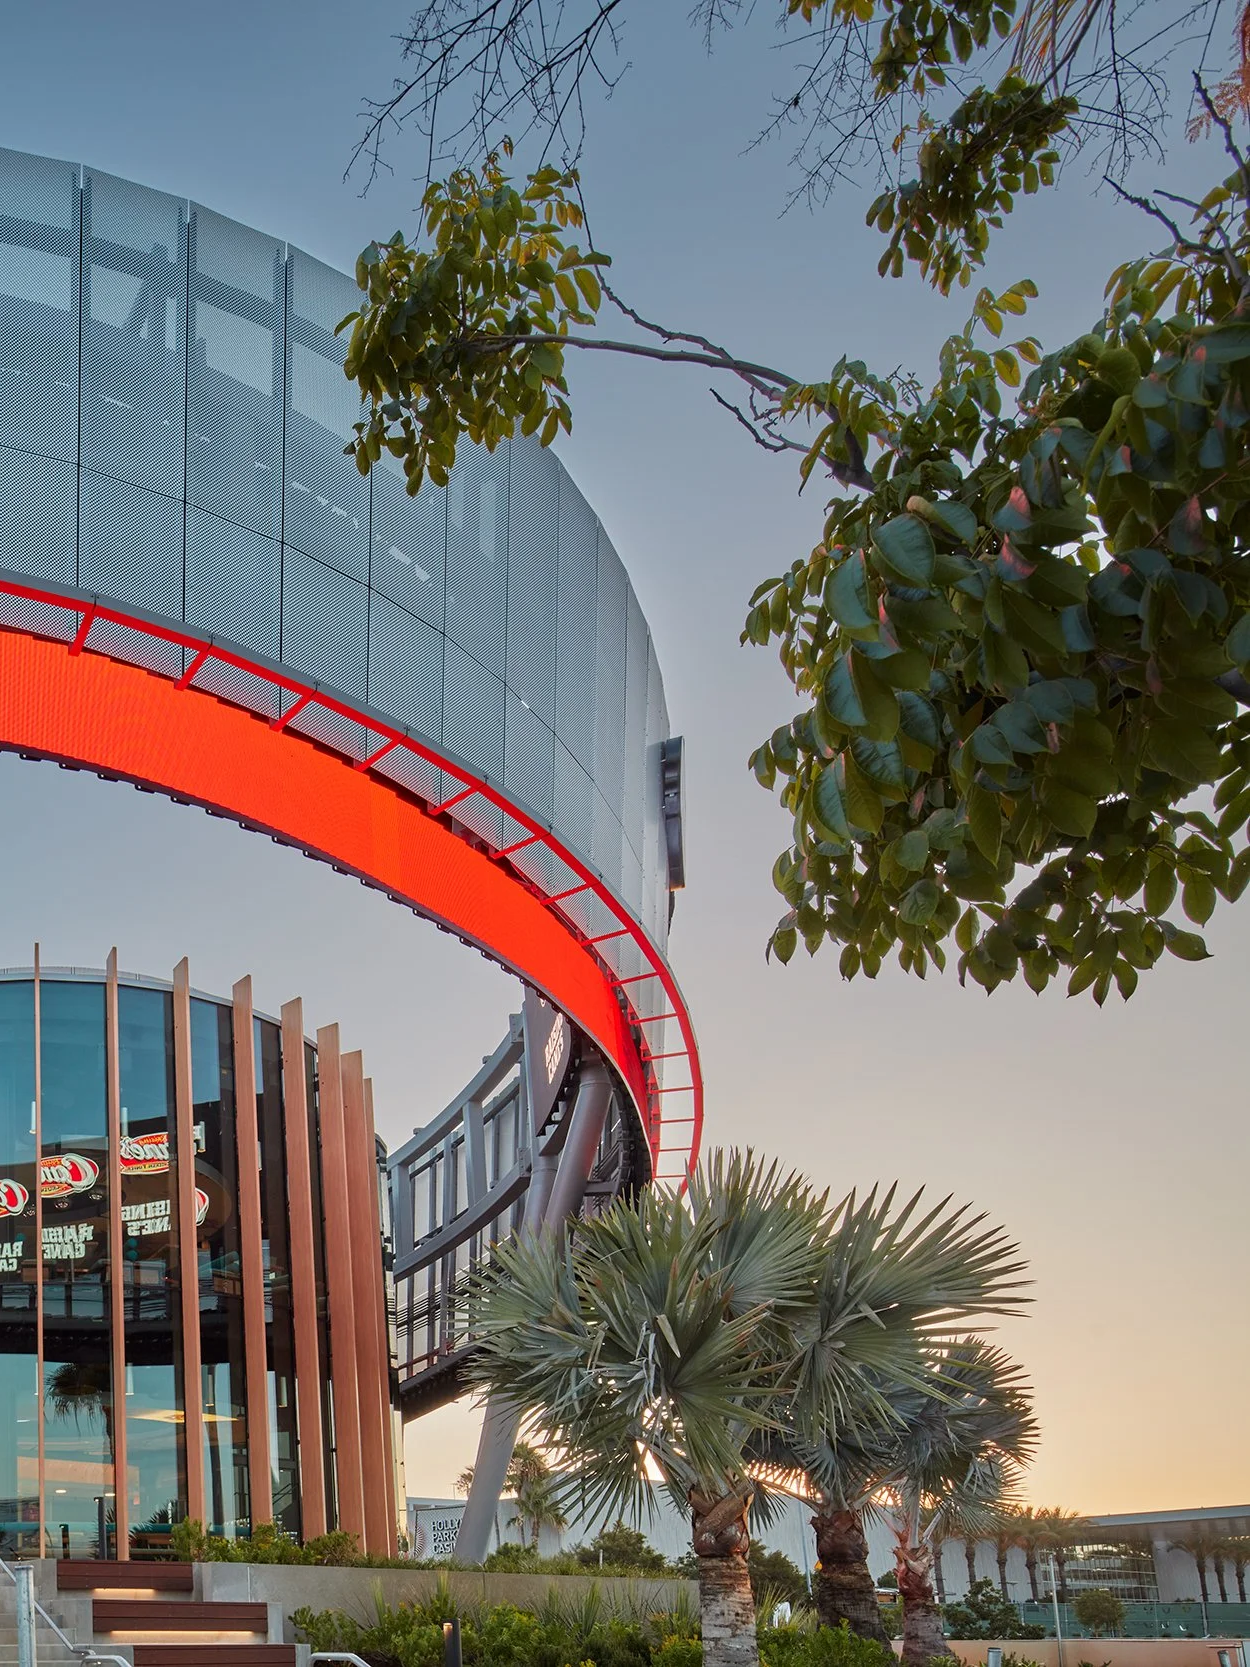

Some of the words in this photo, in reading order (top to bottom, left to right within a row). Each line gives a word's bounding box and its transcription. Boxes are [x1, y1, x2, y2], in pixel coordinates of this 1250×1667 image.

[431, 1518, 462, 1531] HOLLY
[432, 1530, 458, 1542] PARK
[433, 1543, 456, 1554] CASI
